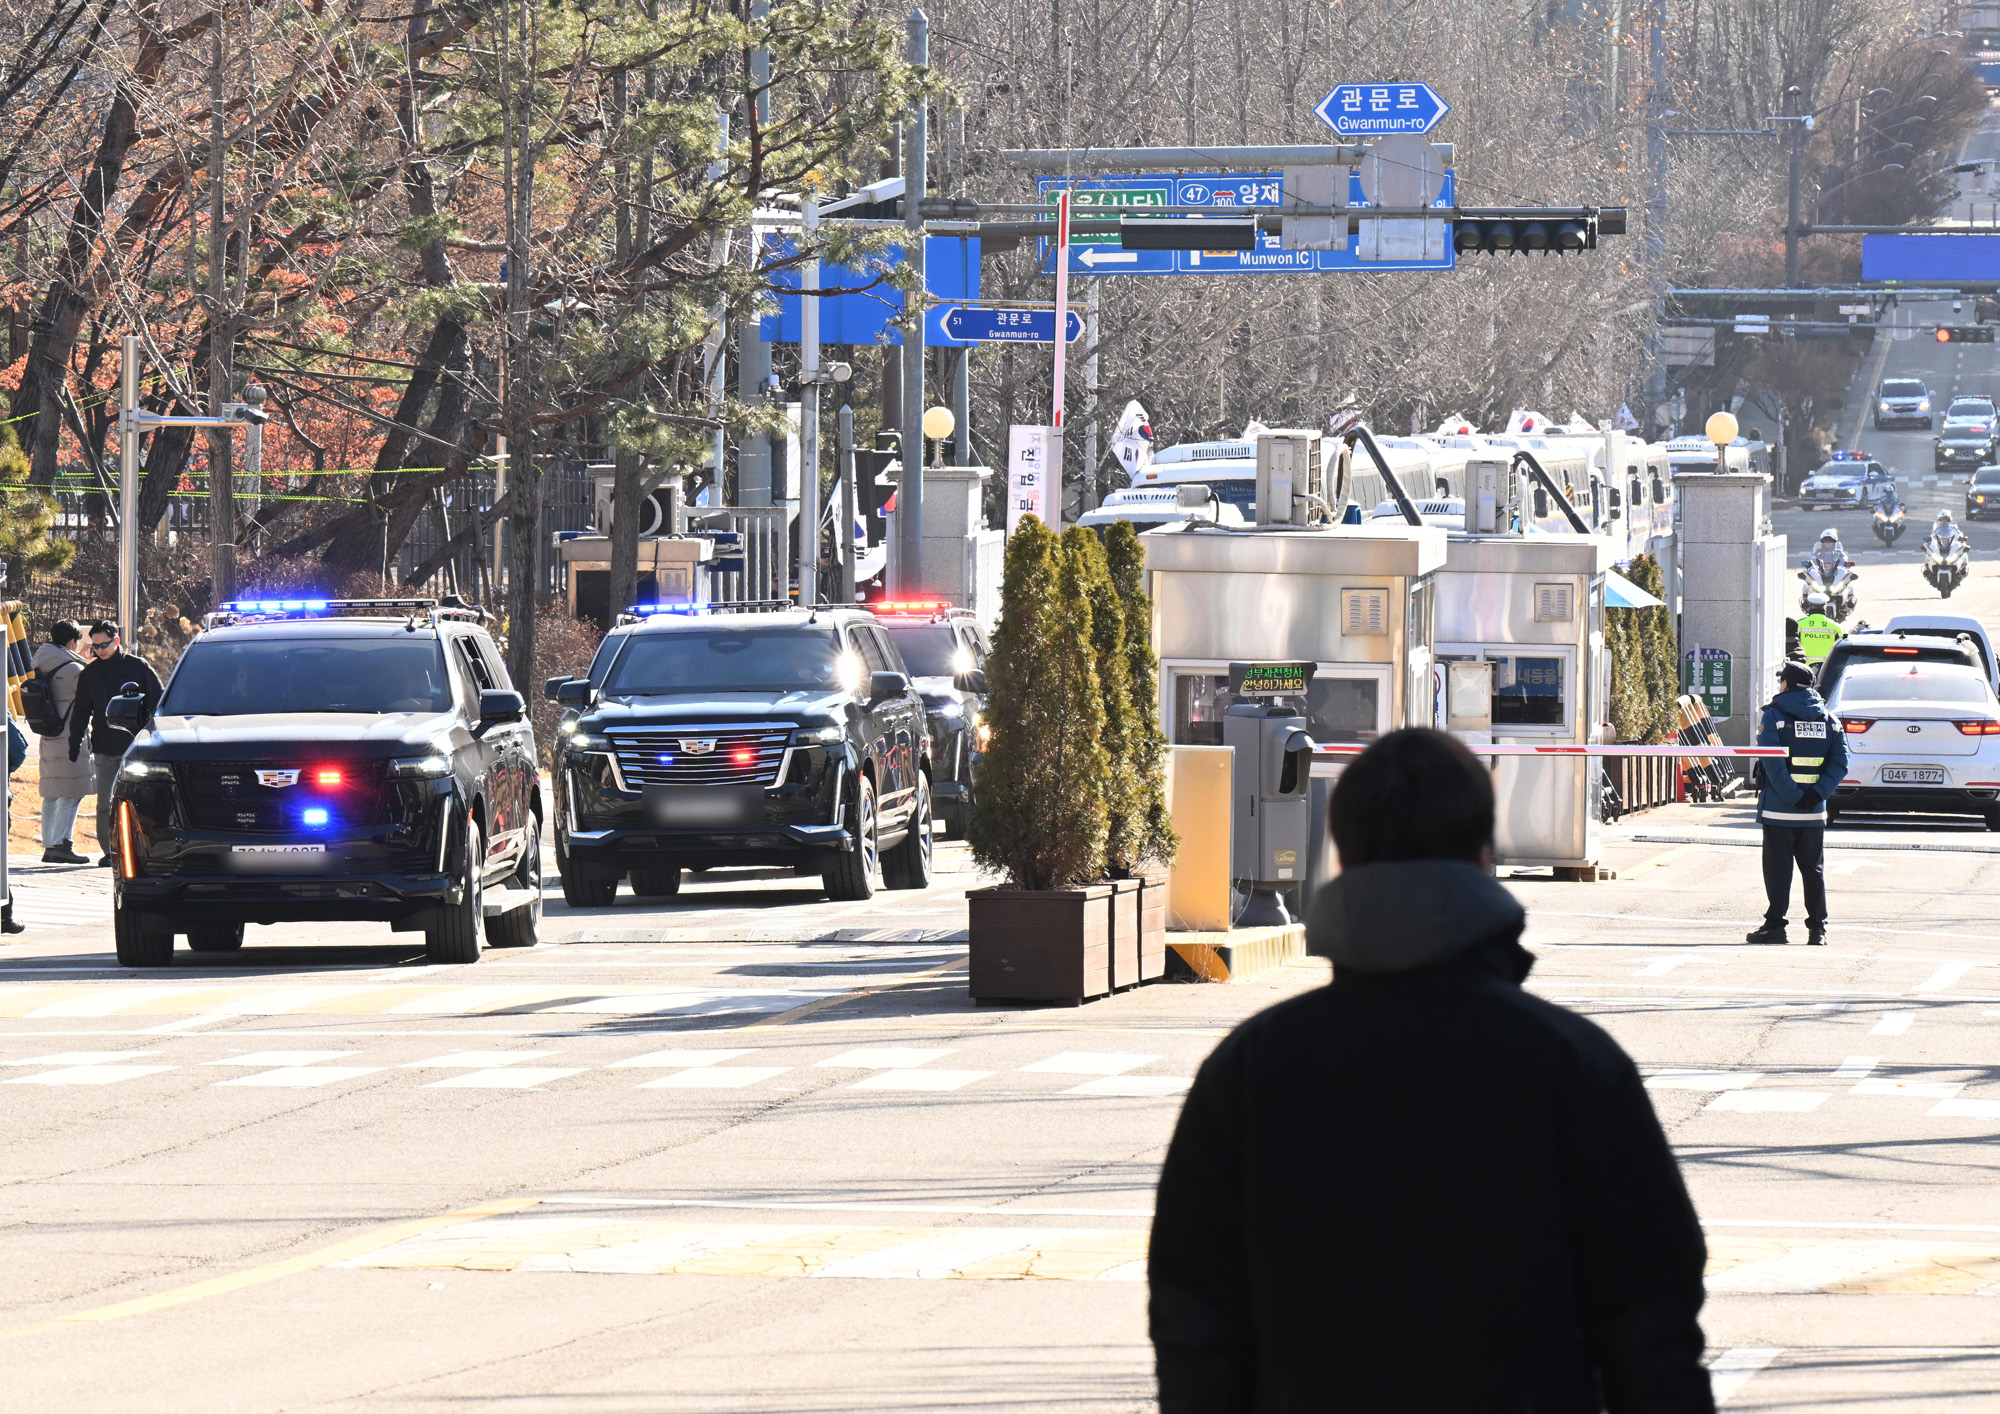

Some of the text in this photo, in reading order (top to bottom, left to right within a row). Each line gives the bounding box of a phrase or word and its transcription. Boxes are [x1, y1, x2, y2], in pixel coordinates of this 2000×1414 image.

[1341, 88, 1419, 111] 관문로
[1338, 115, 1425, 130] Gwanmun-ro
[1186, 188, 1203, 201] 47
[1239, 183, 1279, 204] 양재
[1216, 198, 1232, 206] 100
[1240, 251, 1309, 265] Munwon IC
[953, 317, 962, 325] 51
[996, 313, 1033, 326] 관문로
[989, 329, 1039, 339] Gwanmun-ro
[1244, 679, 1303, 691] 안녕히가세요
[1888, 770, 1938, 780] 04두 1877
